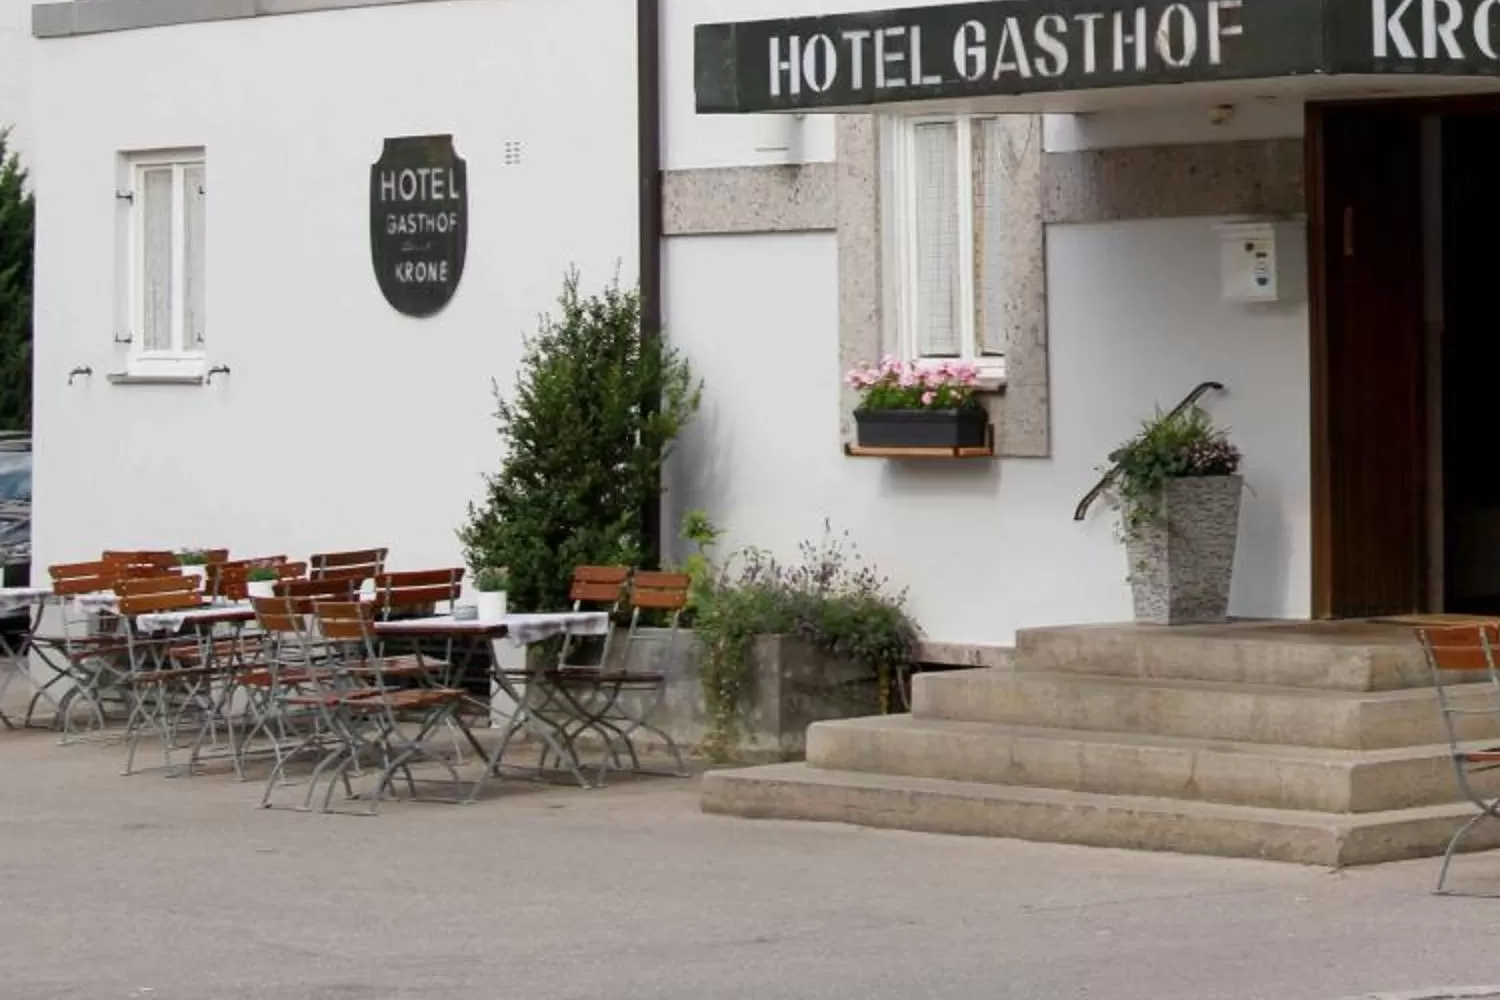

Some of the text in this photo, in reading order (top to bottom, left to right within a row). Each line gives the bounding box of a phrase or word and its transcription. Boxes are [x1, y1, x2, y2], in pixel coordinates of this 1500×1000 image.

[769, 26, 942, 96] HOTEL
[380, 167, 460, 201] HOTEL
[387, 212, 458, 235] GASTHOF
[395, 260, 449, 283] KRONE
